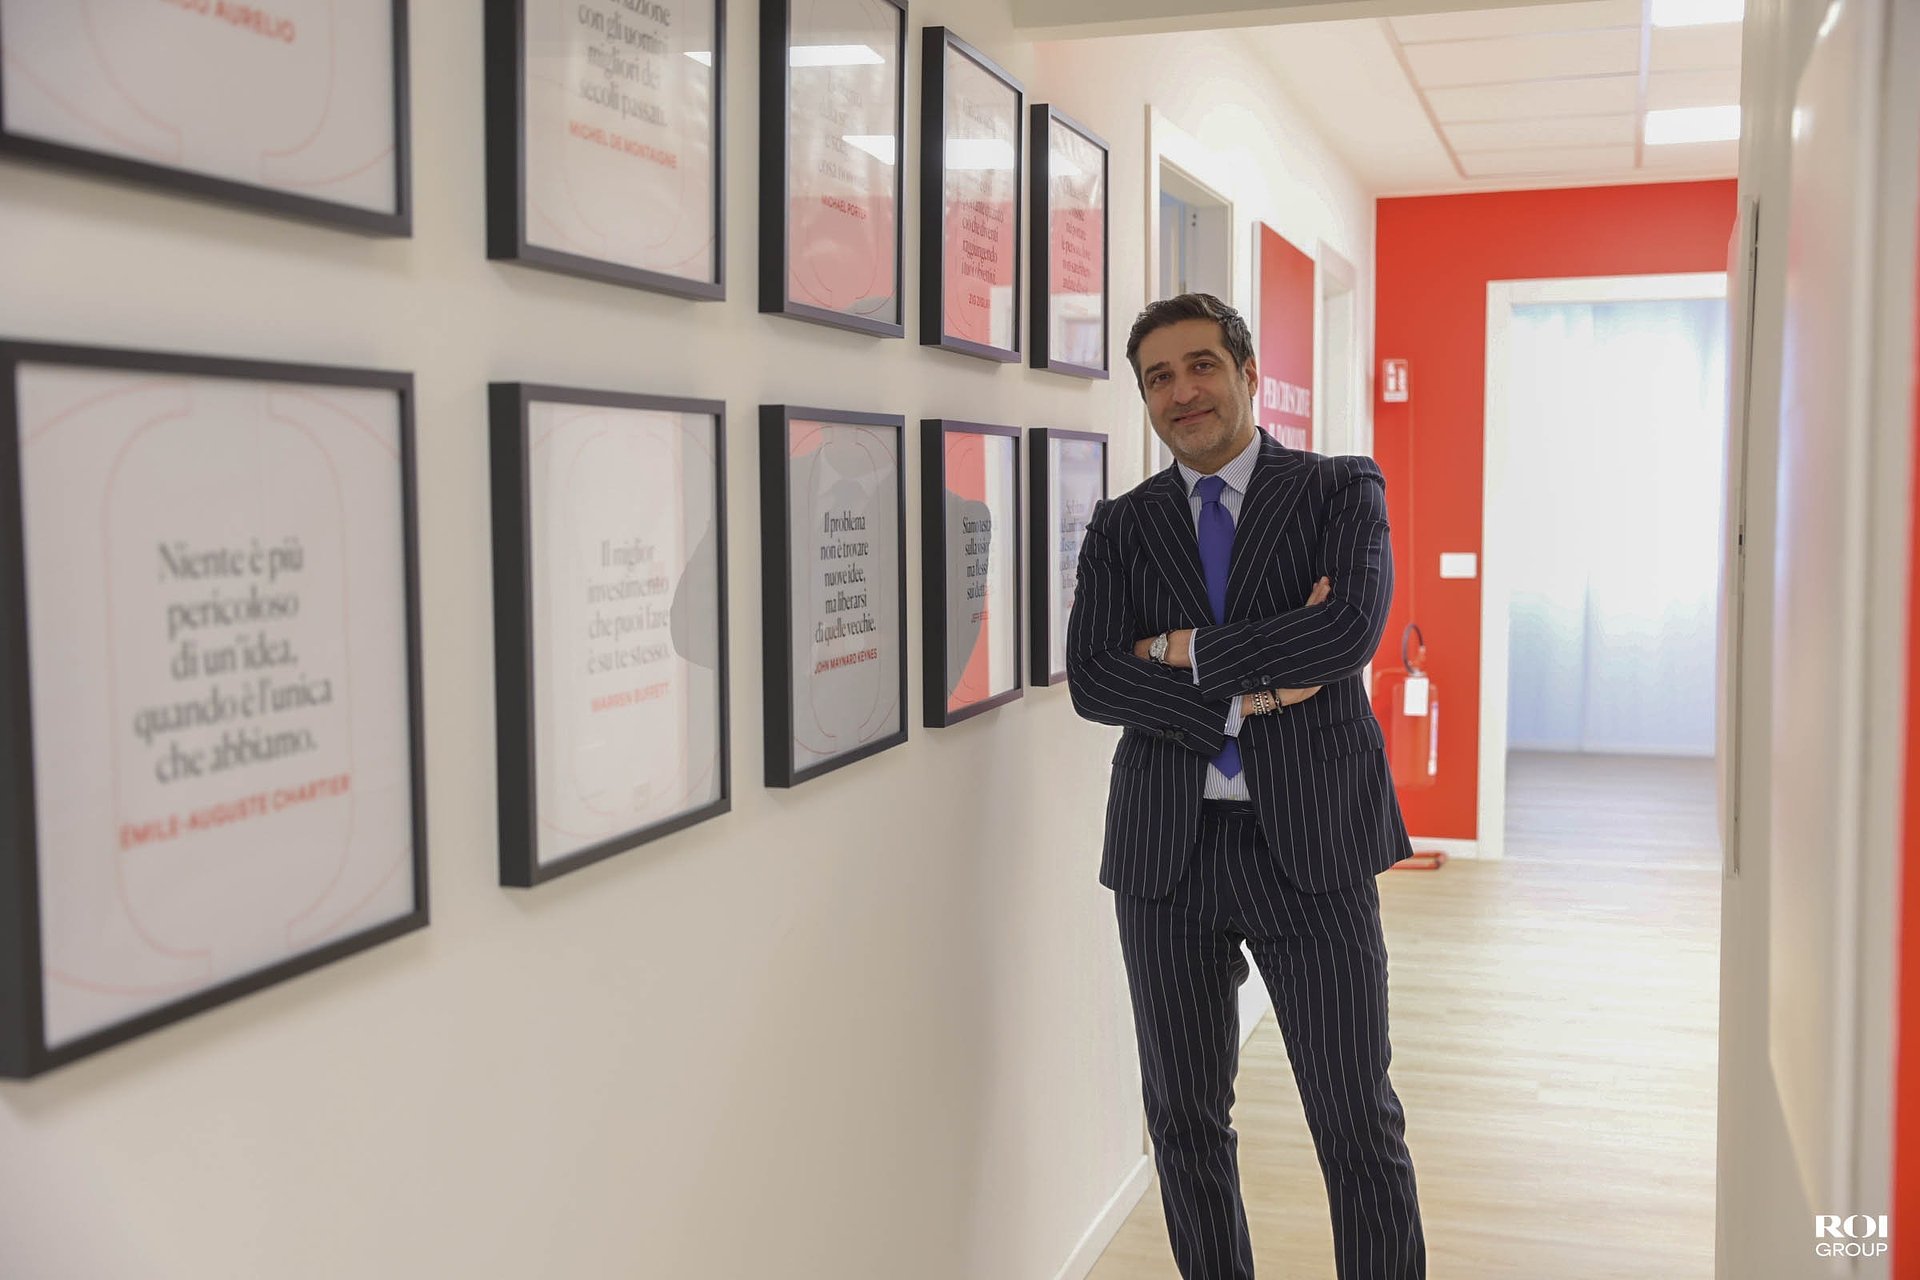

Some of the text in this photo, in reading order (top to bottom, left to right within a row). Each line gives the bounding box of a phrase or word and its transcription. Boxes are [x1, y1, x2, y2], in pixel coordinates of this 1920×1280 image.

[578, 3, 604, 32] con
[823, 509, 866, 538] Il problema
[158, 536, 303, 584] Niente è più
[820, 538, 869, 561] non è trovare
[824, 563, 867, 588] nuove idee,
[167, 585, 300, 642] pericoloso
[825, 587, 868, 614] ma liberarsi
[815, 612, 877, 647] di quelle vecchie.
[170, 639, 197, 682] di
[814, 647, 878, 676] JOHN MAYNARD KEYNES
[134, 683, 237, 747] quando
[155, 741, 204, 785] che
